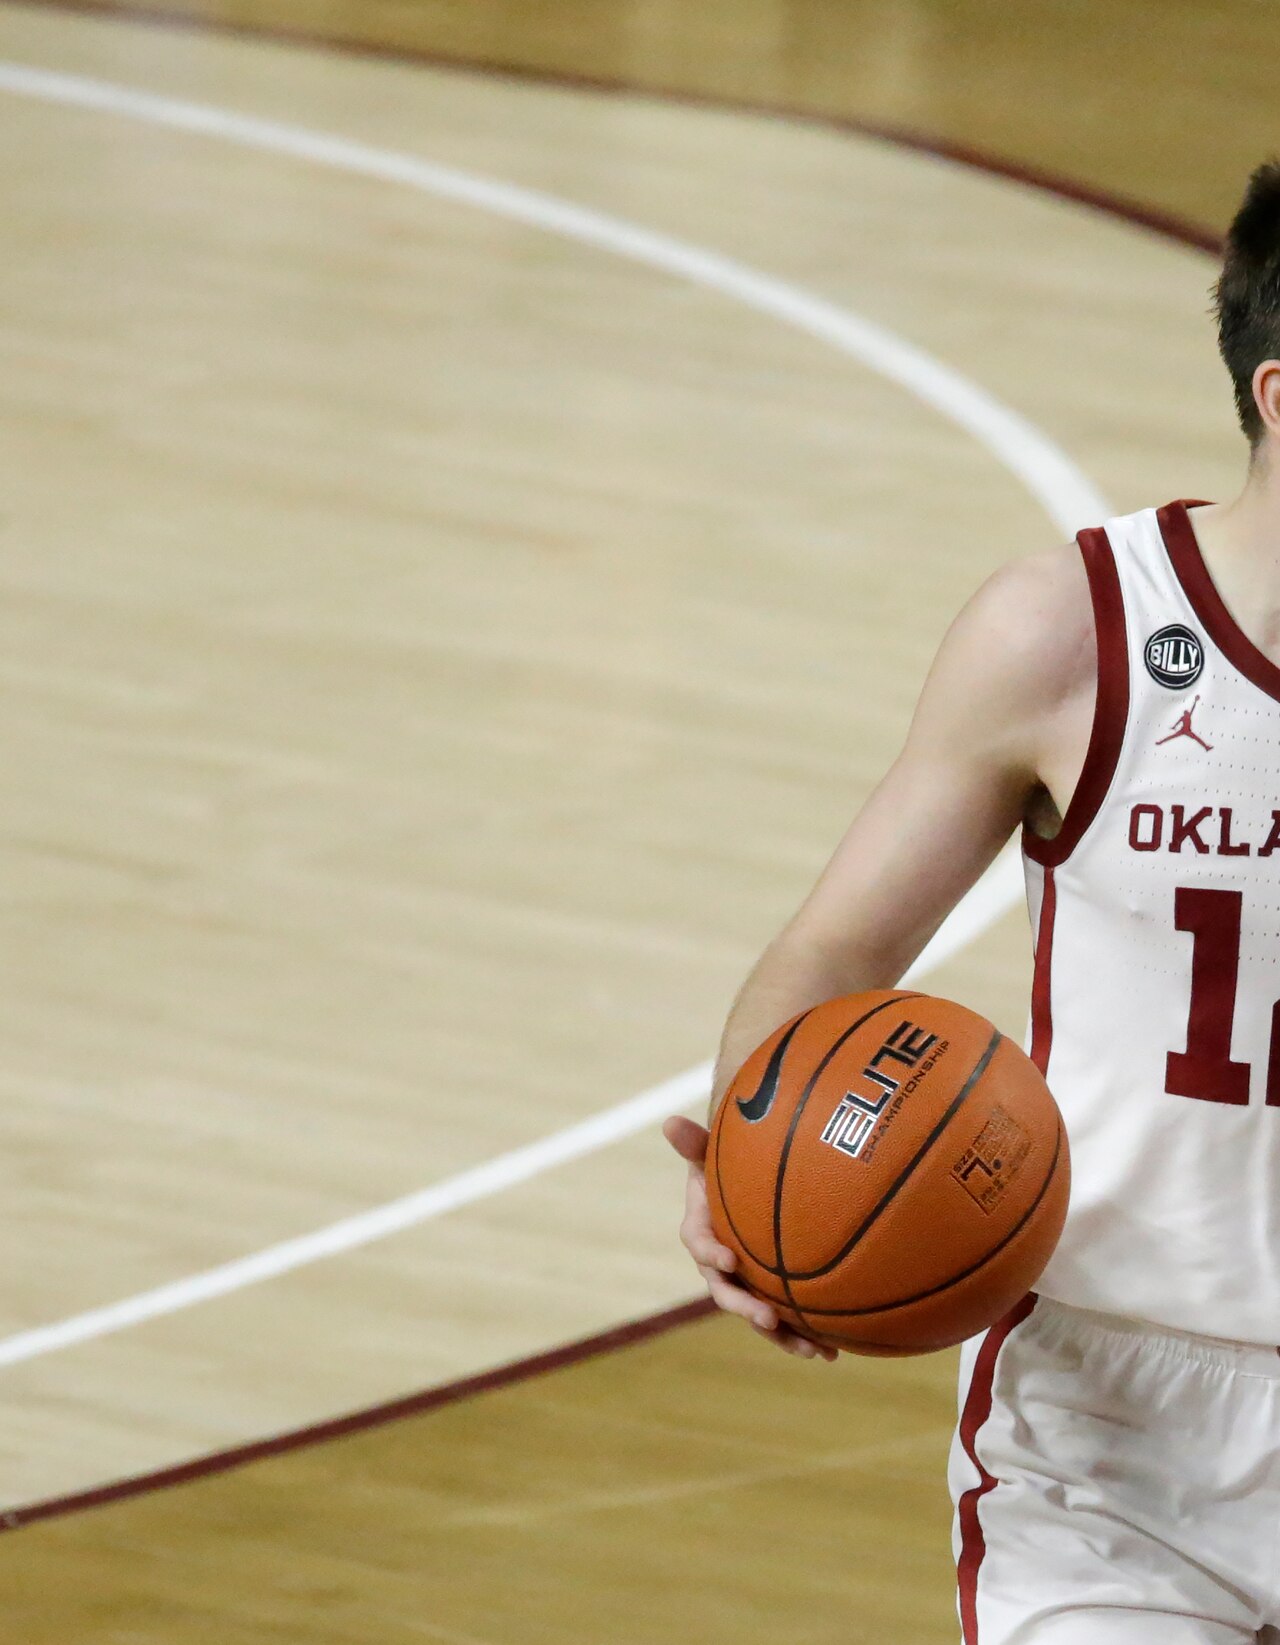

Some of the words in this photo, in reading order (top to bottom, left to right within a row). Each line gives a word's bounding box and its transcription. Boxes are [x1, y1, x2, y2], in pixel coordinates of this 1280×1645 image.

[1150, 640, 1198, 672] BILLY
[820, 1020, 939, 1158] ELITE
[860, 1040, 950, 1164] CHAMPIONSHIP
[953, 1148, 975, 1173] SIZE
